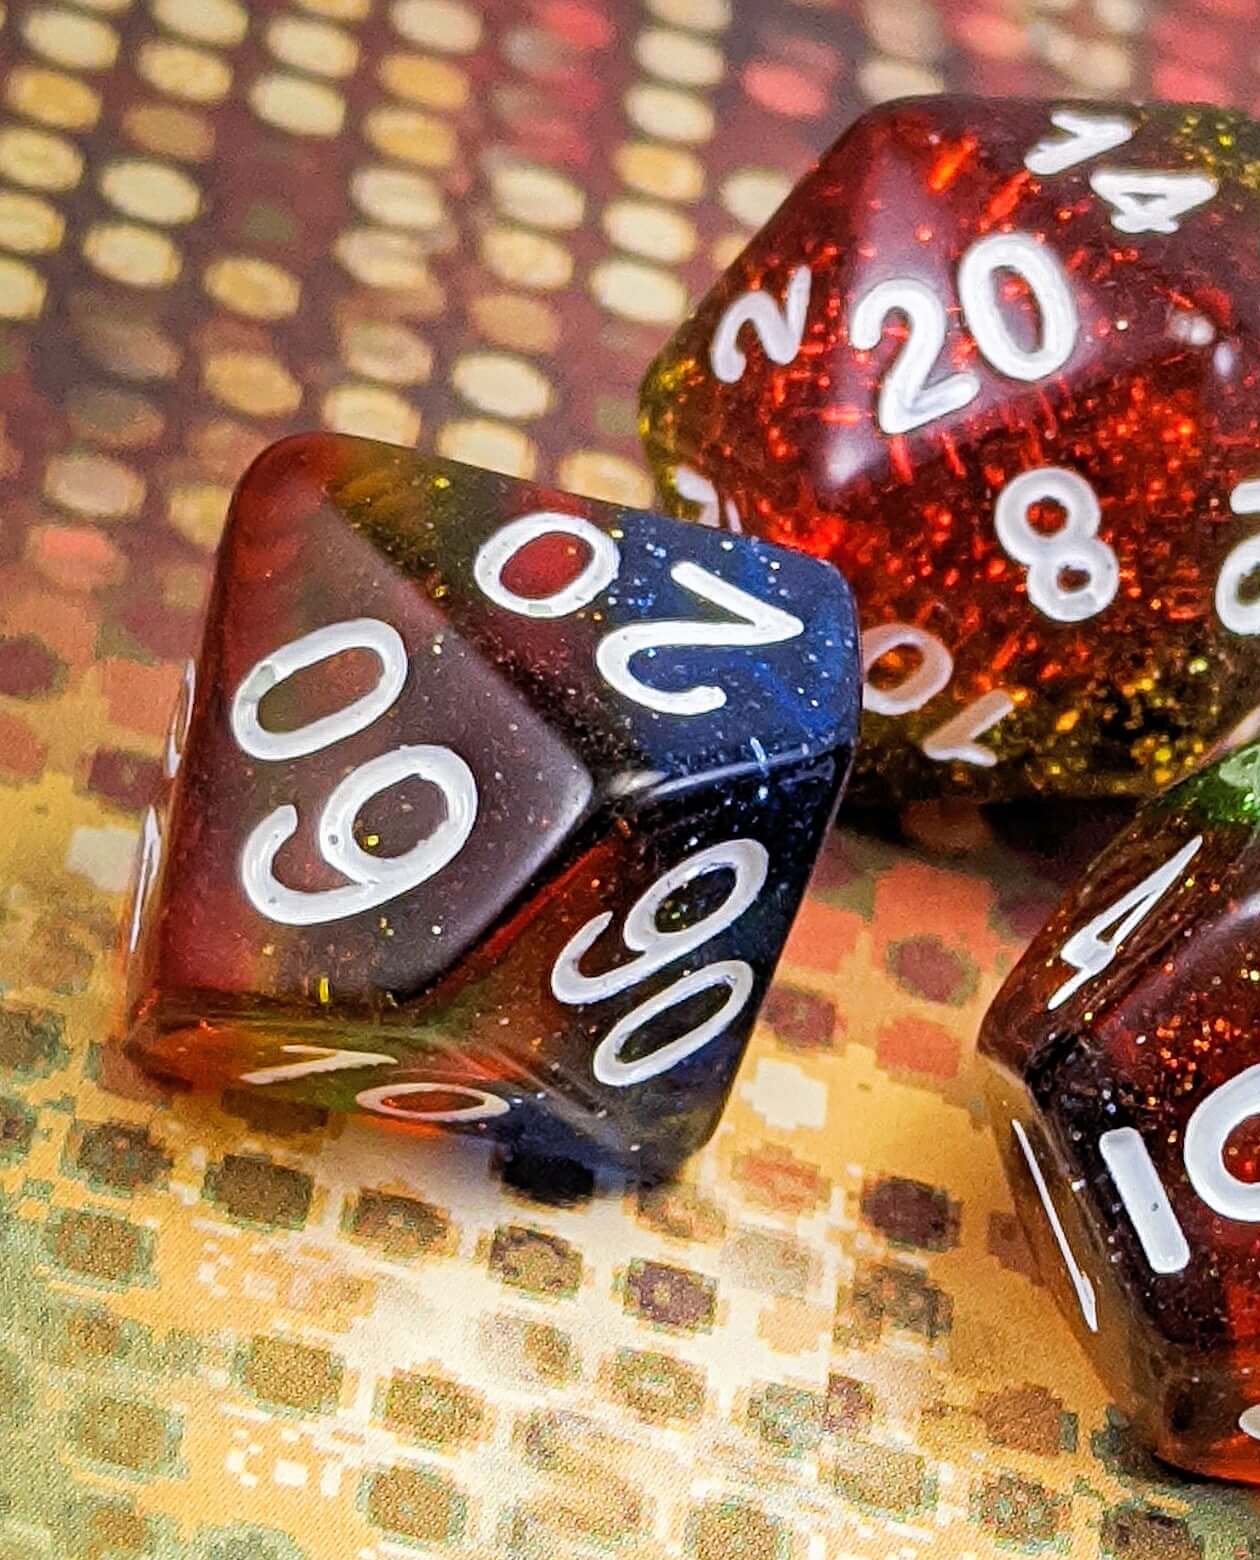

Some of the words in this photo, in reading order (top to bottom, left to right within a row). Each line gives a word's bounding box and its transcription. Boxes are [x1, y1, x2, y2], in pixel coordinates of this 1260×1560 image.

[1026, 110, 1219, 233] 14
[713, 266, 811, 384] 2
[851, 232, 1078, 434] 20
[474, 512, 804, 715] 20
[994, 466, 1120, 622] 8
[1048, 836, 1203, 1010] 4
